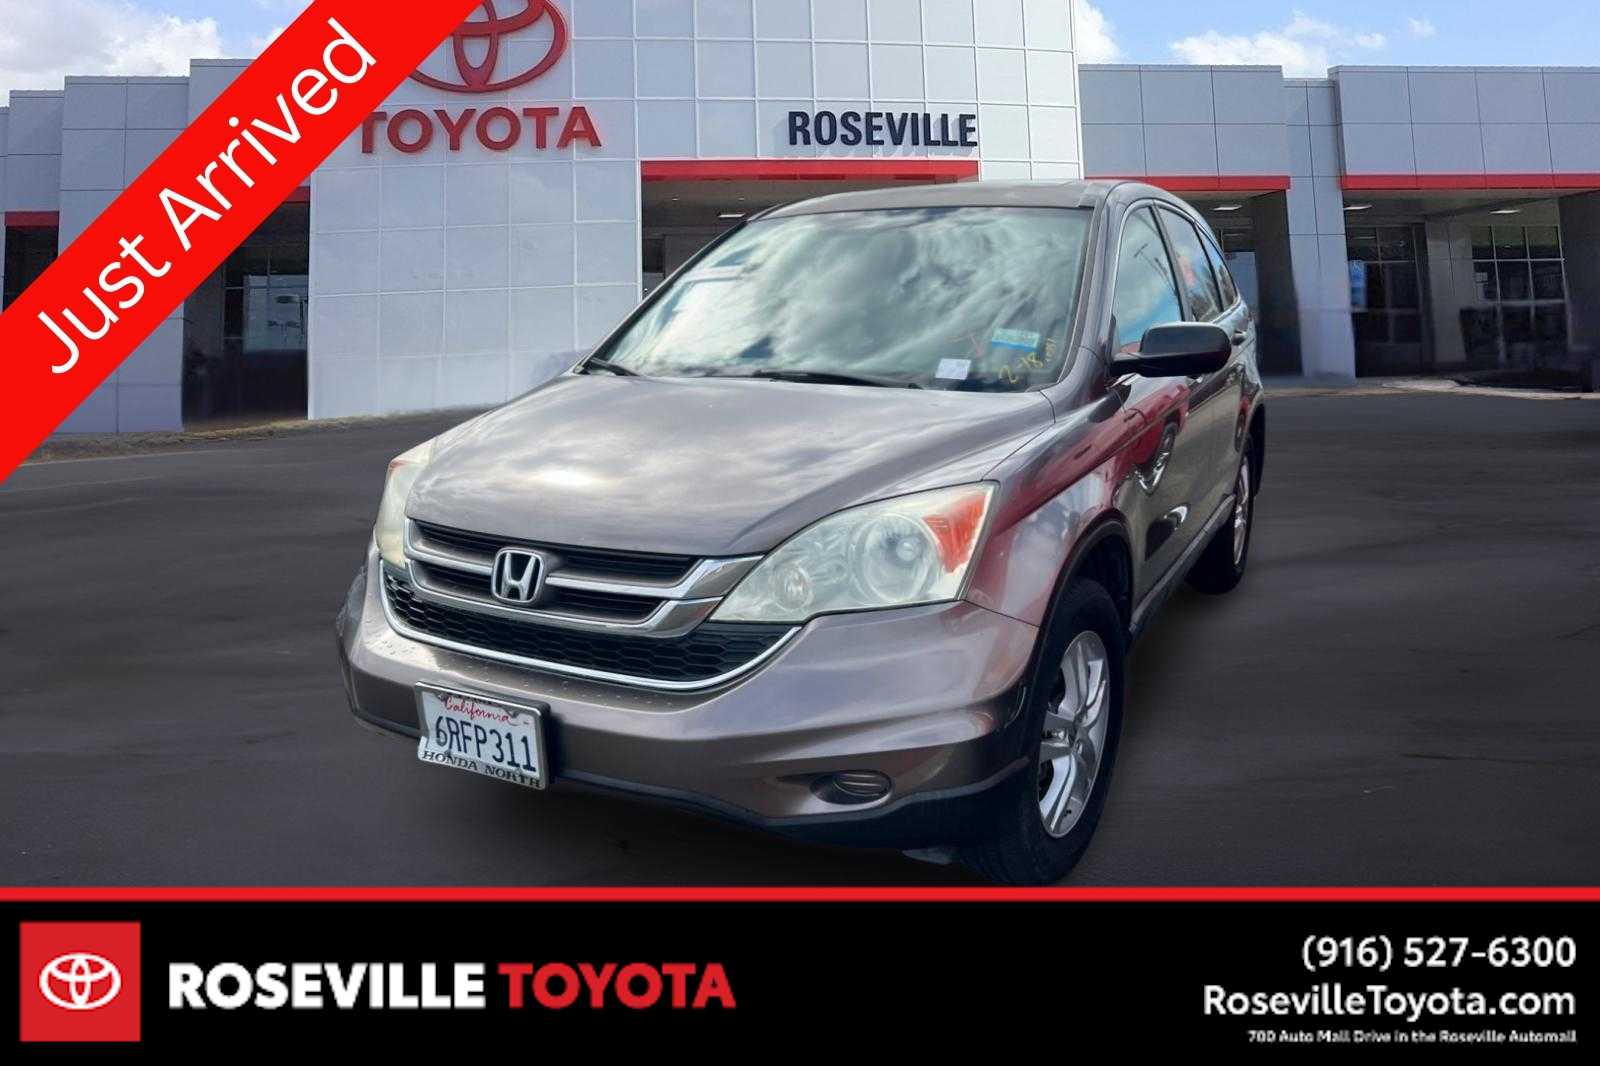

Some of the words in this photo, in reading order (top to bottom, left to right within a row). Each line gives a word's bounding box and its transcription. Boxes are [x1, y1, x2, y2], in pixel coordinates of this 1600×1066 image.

[361, 106, 603, 154] TOYOTA
[788, 110, 978, 147] ROSEVILLE
[443, 695, 513, 723] California
[435, 715, 537, 773] 6RFP311
[422, 750, 479, 771] HONDA
[484, 764, 541, 788] NORTH
